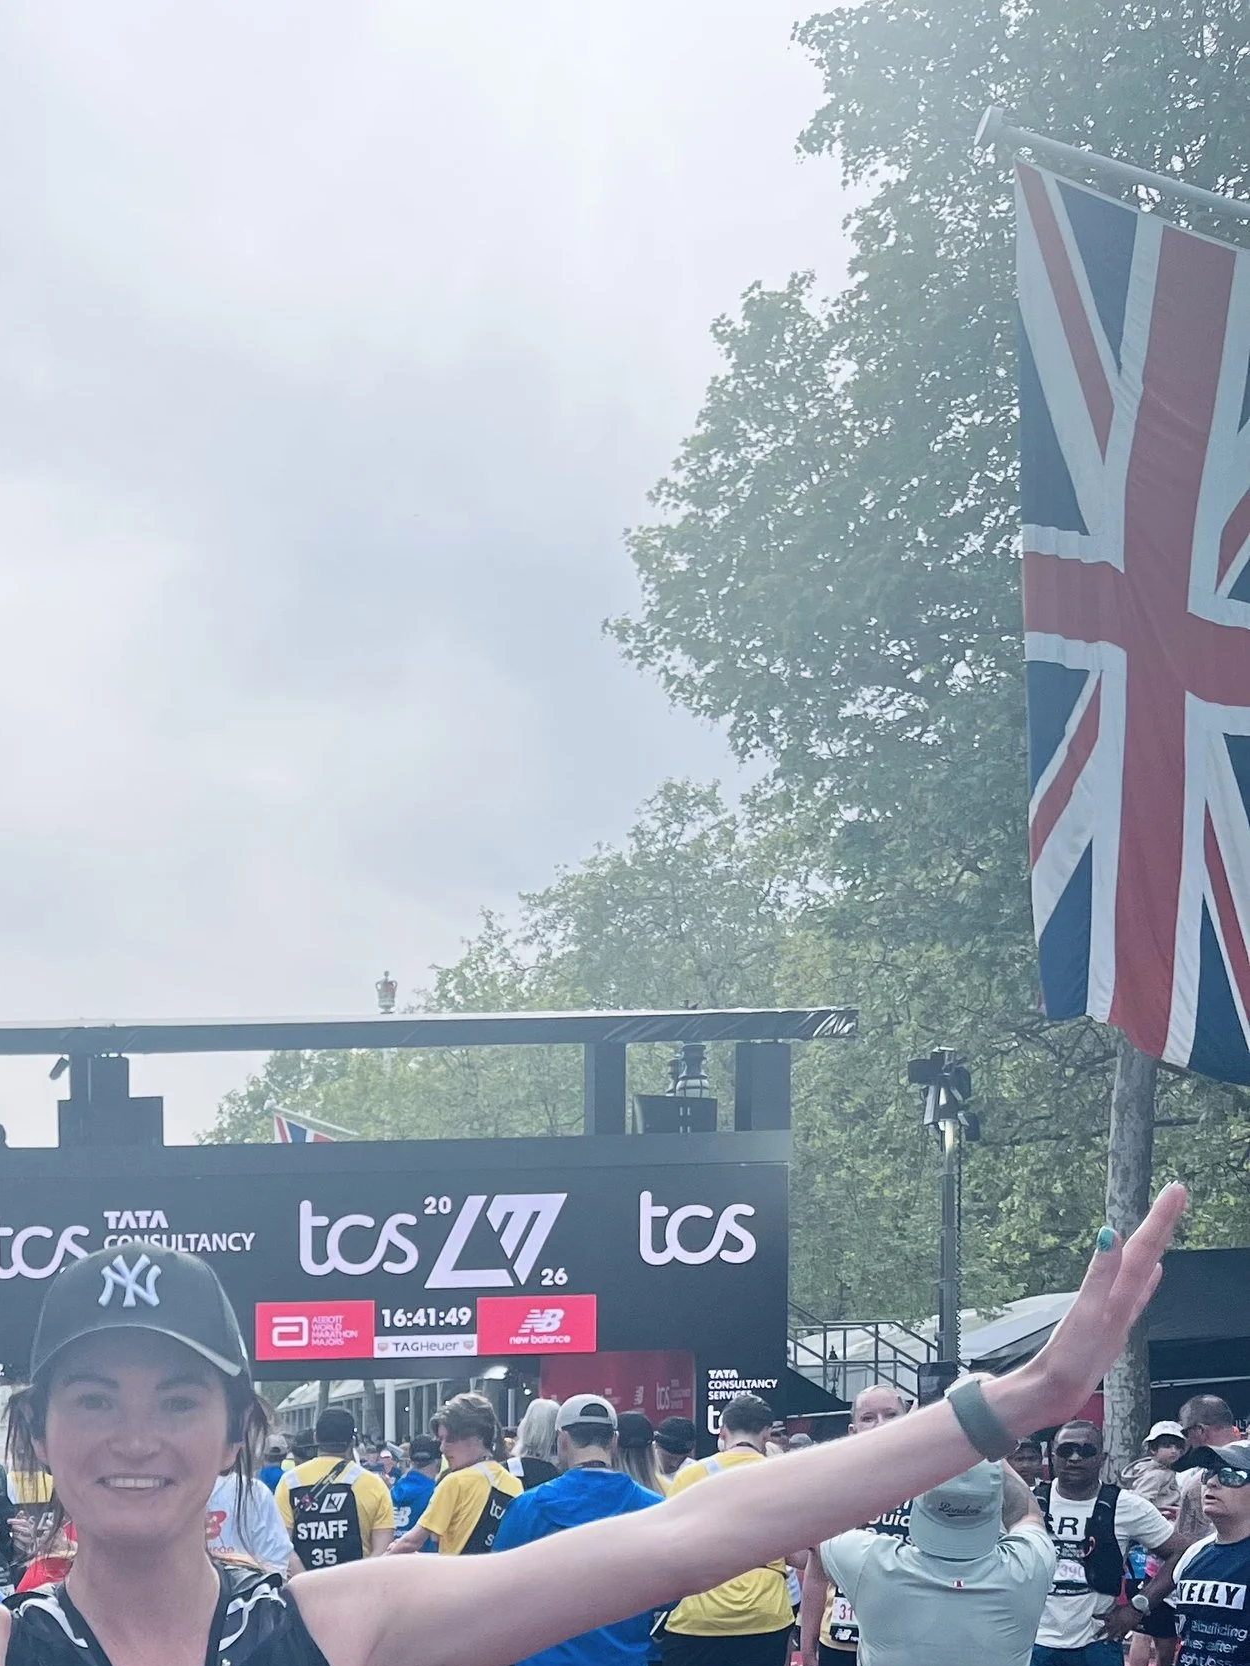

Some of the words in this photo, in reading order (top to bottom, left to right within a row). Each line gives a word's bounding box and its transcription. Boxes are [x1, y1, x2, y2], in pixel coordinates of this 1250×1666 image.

[424, 1197, 452, 1215] 20
[103, 1210, 169, 1229] TATA
[638, 1190, 756, 1267] tcs
[299, 1200, 419, 1276] tcs
[540, 1268, 568, 1287] 26
[312, 1315, 343, 1323] ABBOTT
[381, 1306, 472, 1328] 16:41:49
[312, 1323, 342, 1331] WORLD
[312, 1330, 358, 1338] MARATHON
[312, 1337, 344, 1345] MAJORS
[509, 1335, 529, 1344] new
[531, 1333, 570, 1344] balance
[707, 1369, 739, 1379] TATA
[707, 1379, 778, 1390] CONSULTANCY
[297, 1520, 348, 1540] STAFF
[311, 1548, 337, 1566] 35
